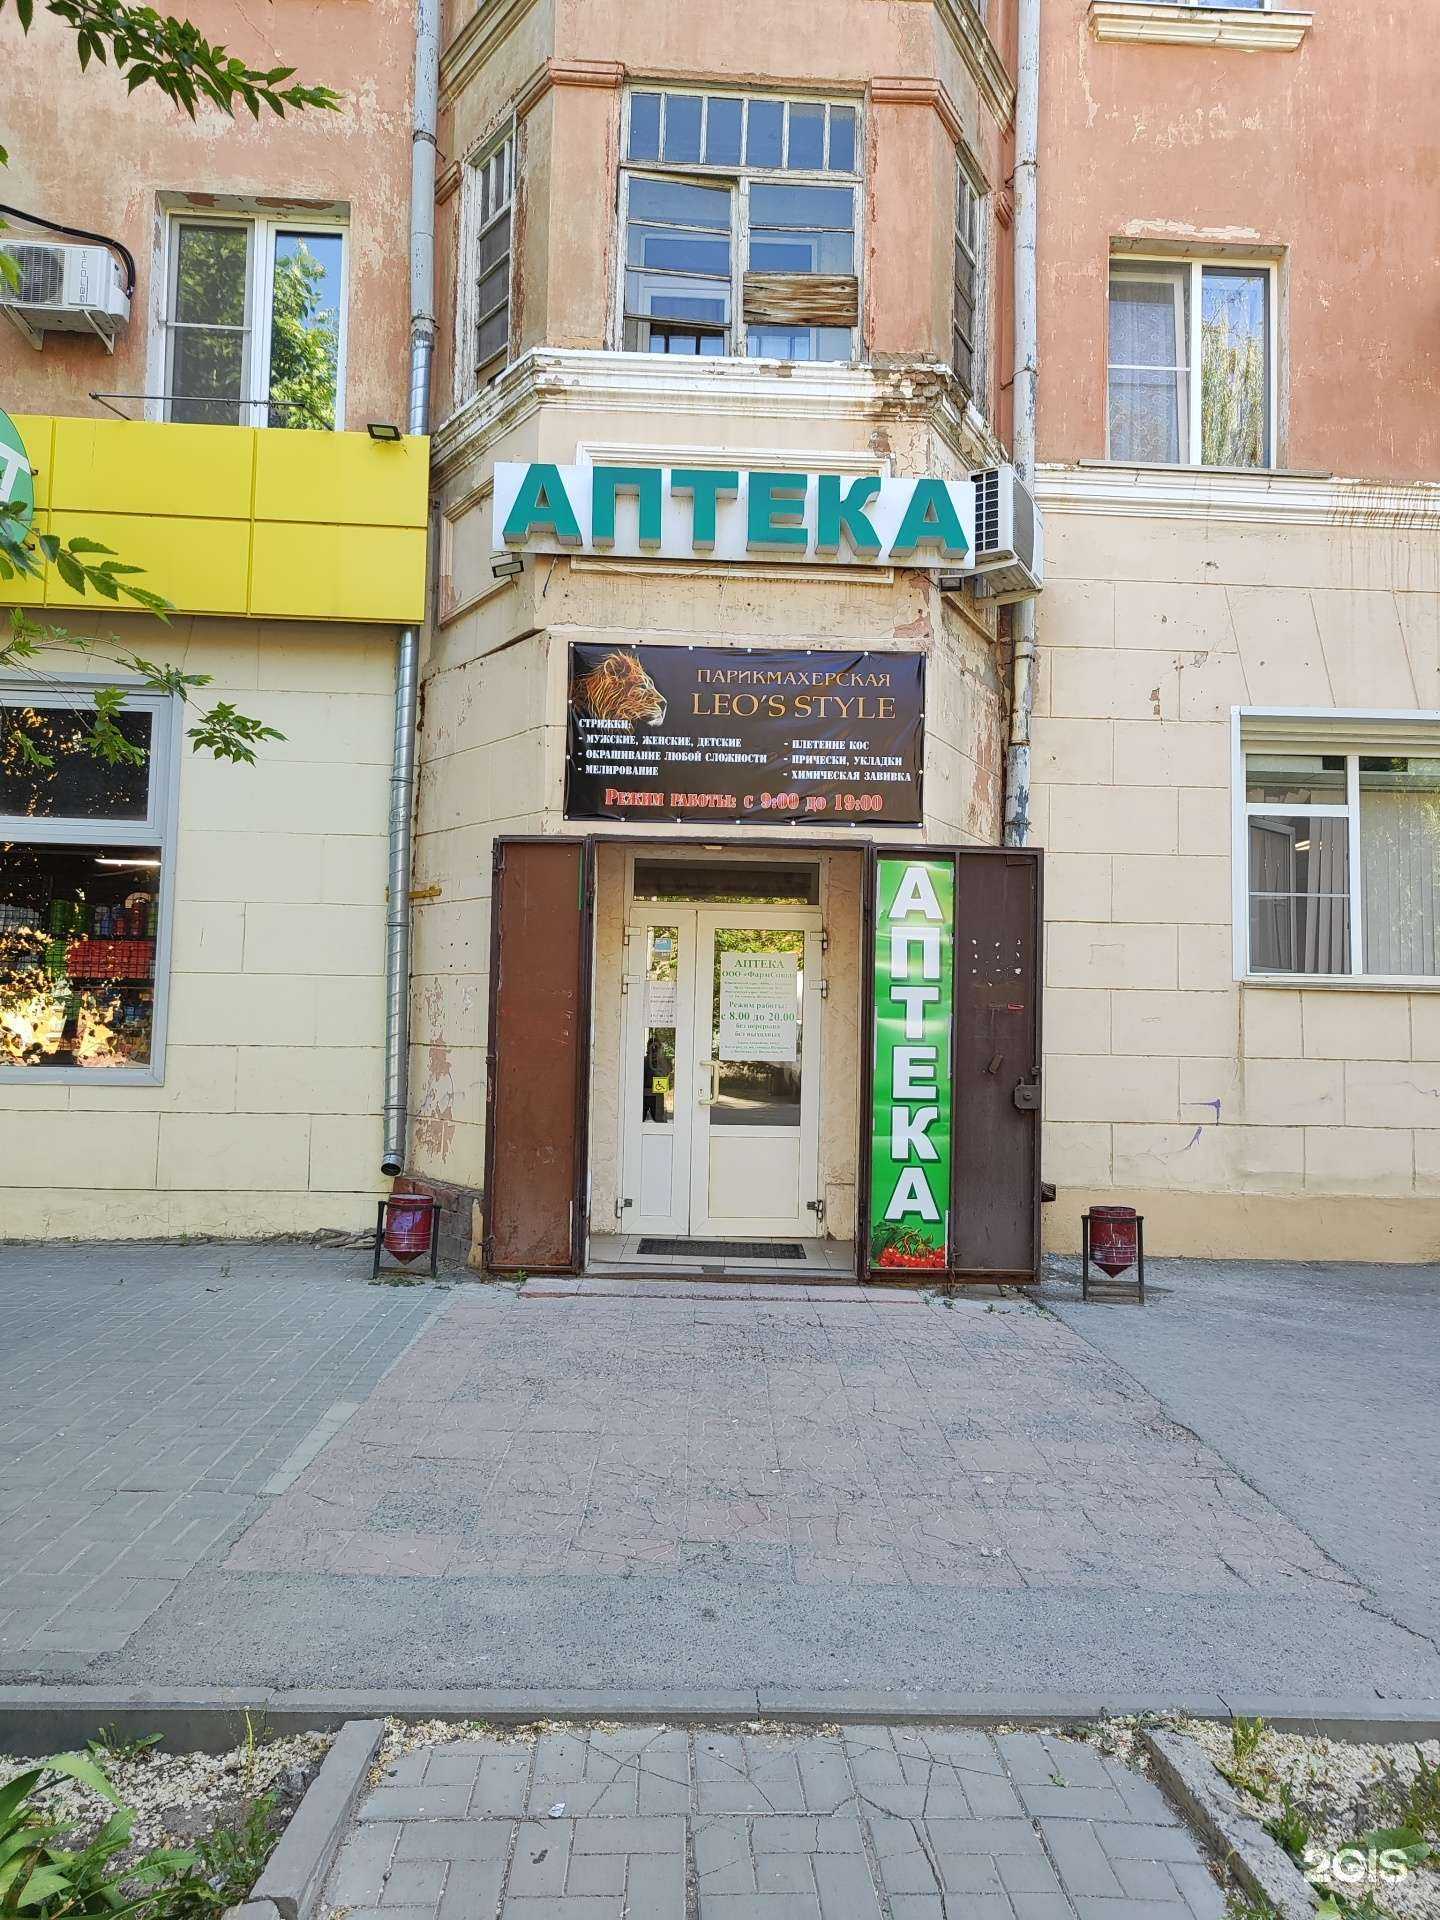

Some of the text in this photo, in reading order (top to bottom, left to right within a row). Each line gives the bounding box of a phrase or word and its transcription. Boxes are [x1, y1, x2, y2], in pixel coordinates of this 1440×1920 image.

[502, 463, 969, 559] АПТЕКА
[697, 669, 890, 687] ПАРИКМАХЕРСКАЯ
[692, 692, 896, 719] LEO'S STYLE
[586, 734, 742, 748] МУЖСКИЕ, ЖЕНСКИЕ, ДЕТСКИЕ
[792, 740, 870, 751] ПЛЕТЕНИЕ КОС
[586, 750, 768, 764] ОКРАШИВАНИЕ ЛЮБОЙ СЛОЖНОСТИ
[792, 755, 902, 767] ПРИЧЕСКИ, УКЛАДКИ
[585, 765, 659, 776] МЕЛИРОВАНИЕ
[792, 770, 912, 782] ХИМИЧЕСКАЯ ЗАВИВКА
[760, 792, 800, 810] 9:00
[834, 793, 883, 812] 19:00
[734, 959, 785, 969] АПТЕКА
[729, 1011, 750, 1021] 8.00
[752, 1013, 766, 1023] до
[768, 1012, 795, 1023] 20.00
[884, 866, 945, 1222] АПТЕКА
